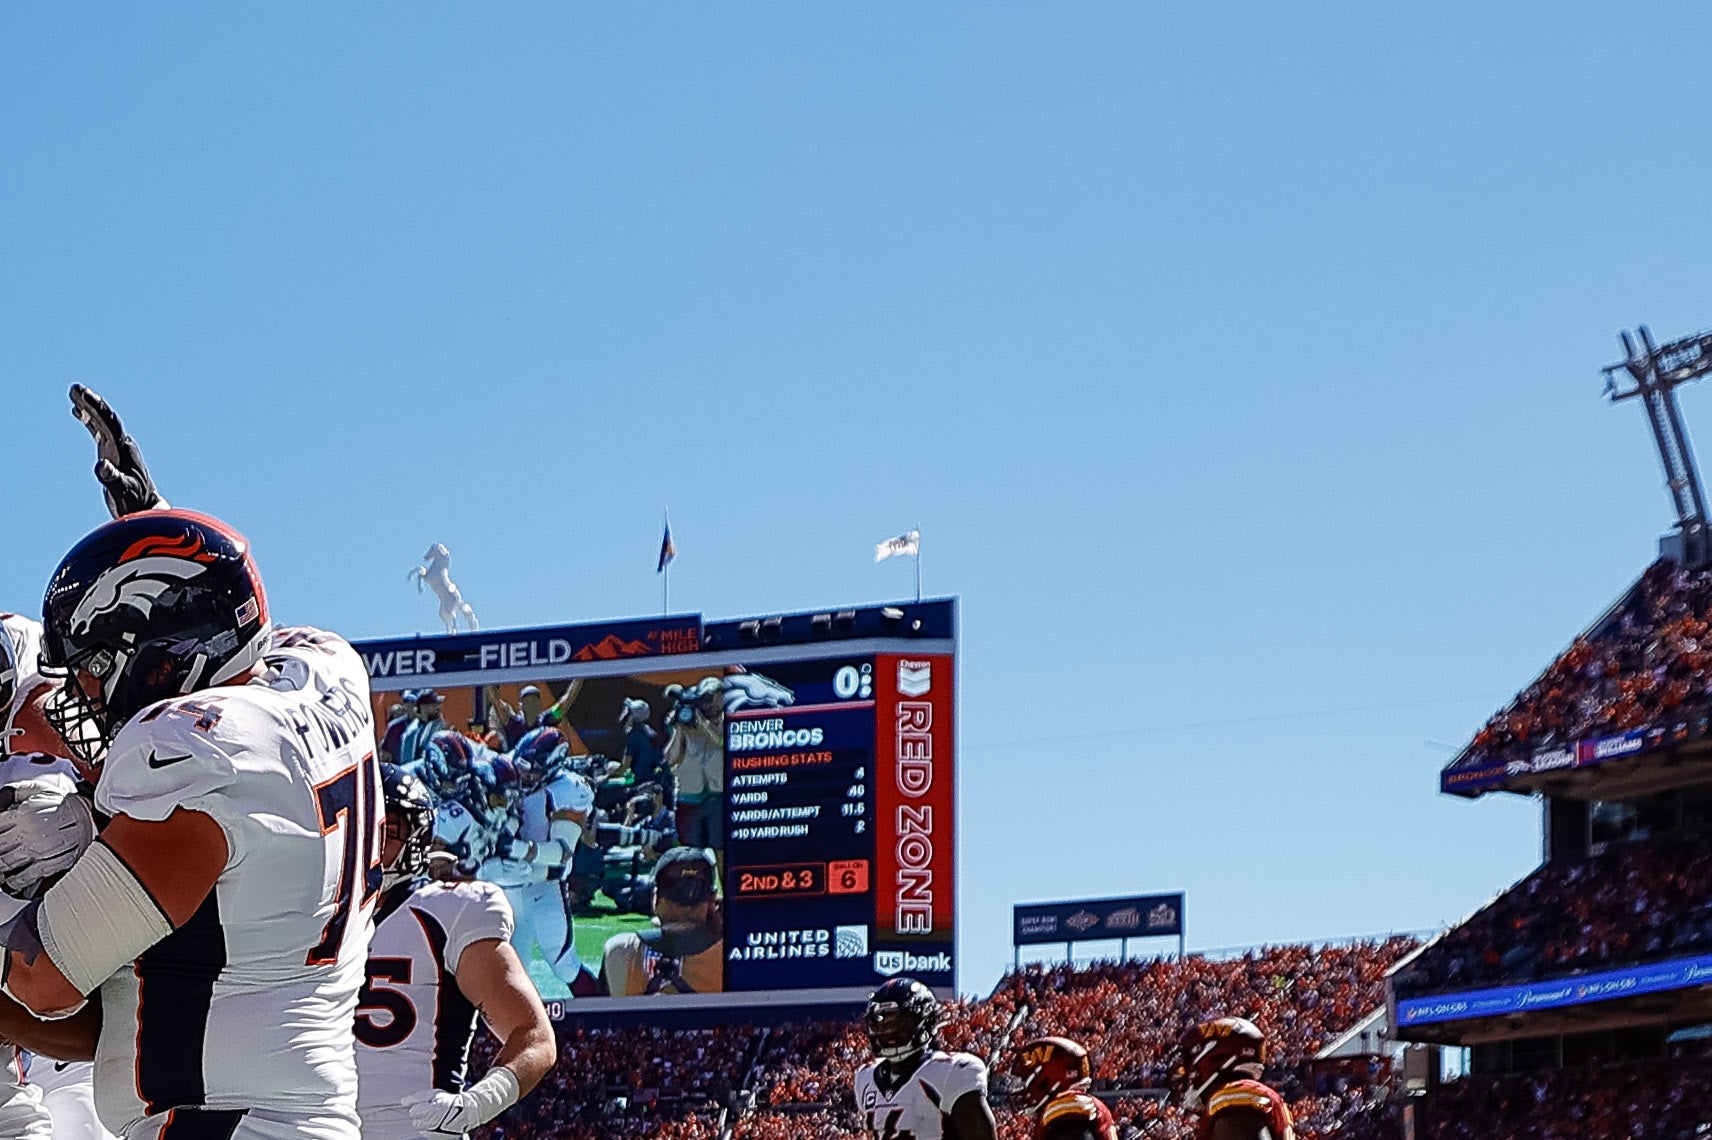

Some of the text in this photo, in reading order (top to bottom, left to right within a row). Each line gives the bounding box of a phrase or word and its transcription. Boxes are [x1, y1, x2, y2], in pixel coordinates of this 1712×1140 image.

[661, 628, 697, 641] MILE
[479, 639, 572, 669] FIELD
[661, 640, 699, 653] HIGH
[729, 719, 784, 734] DENVER
[729, 728, 824, 751] BRONCOS
[733, 751, 833, 769] RUSHING STATS
[731, 772, 788, 787] ATTEMPTS
[731, 792, 768, 805] YARDS
[896, 702, 933, 935] RED ZONE
[740, 870, 814, 891] 2ND & 3
[841, 869, 857, 889] 6
[748, 929, 830, 945] UNITED
[728, 943, 830, 960] AIRLINES
[903, 952, 952, 971] bank
